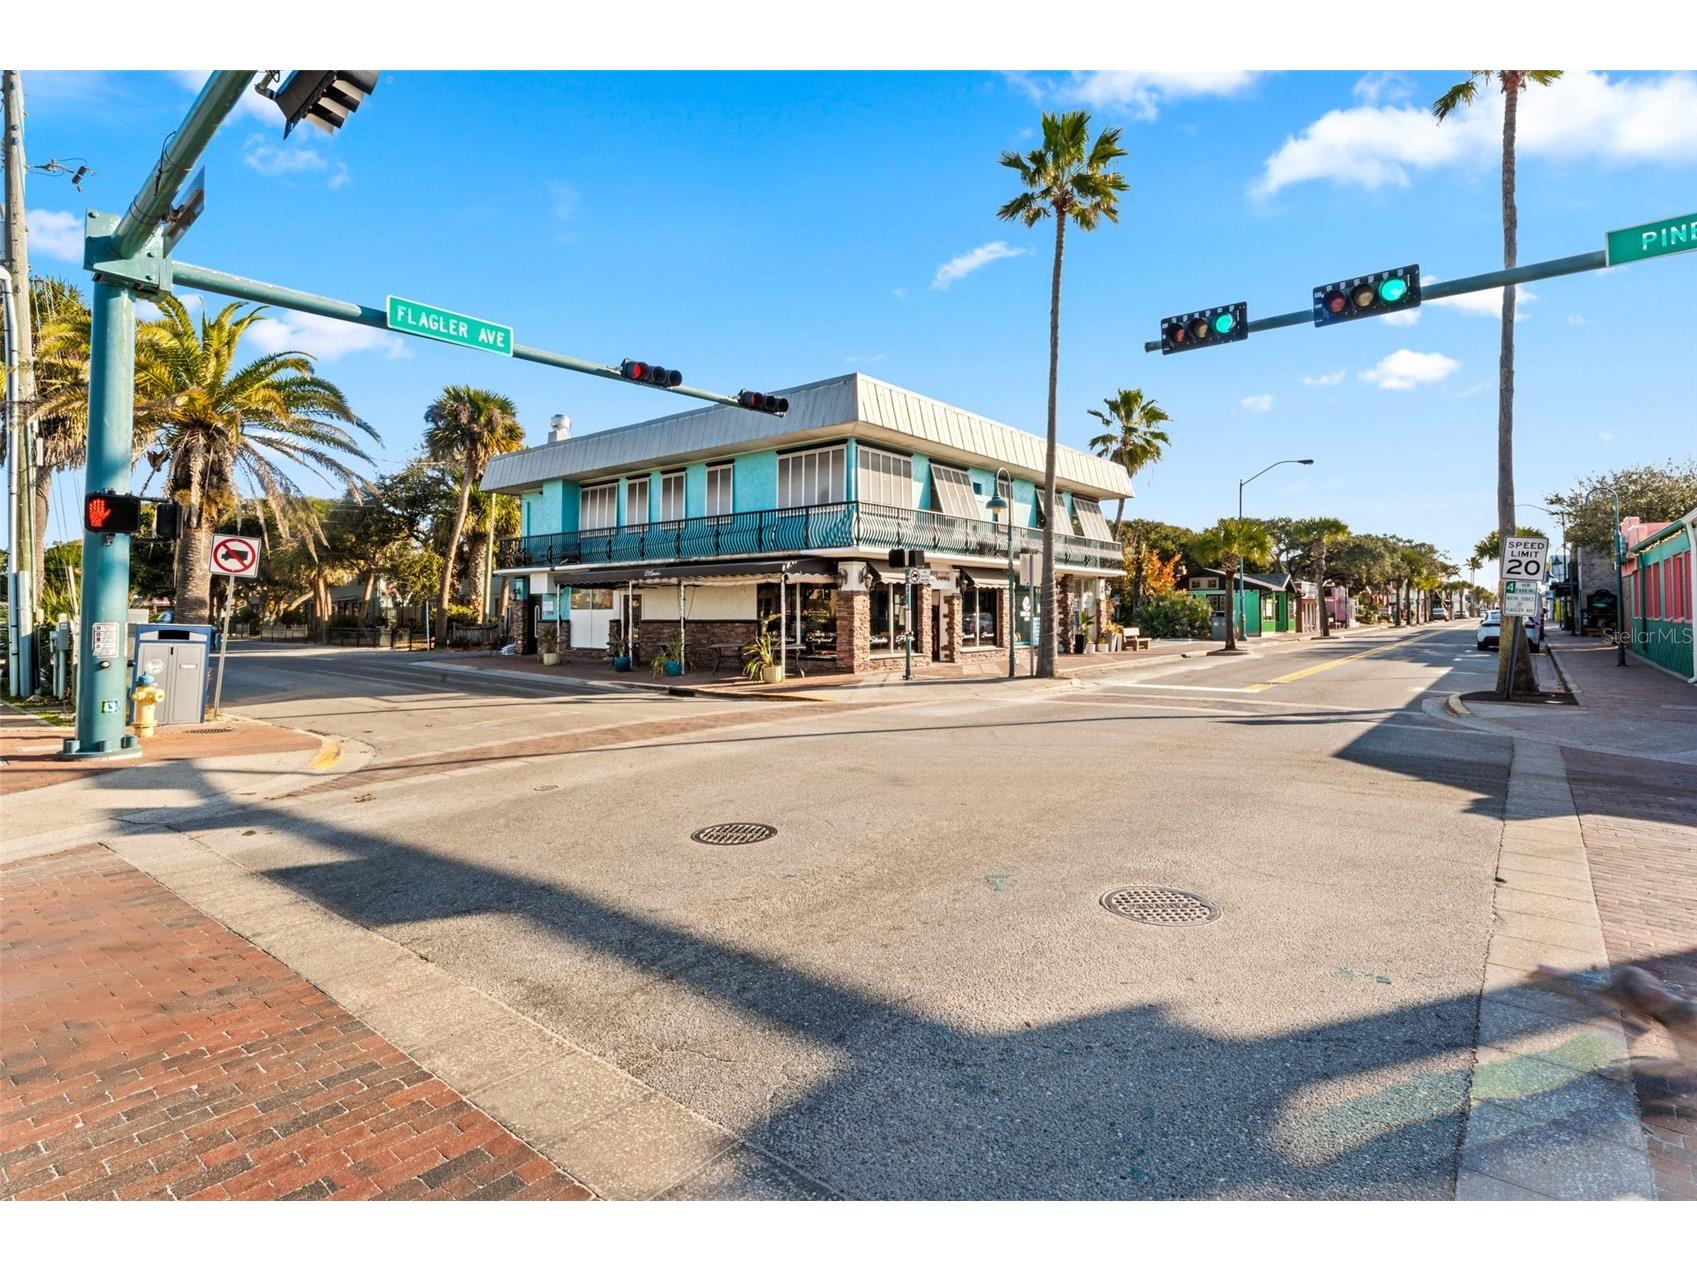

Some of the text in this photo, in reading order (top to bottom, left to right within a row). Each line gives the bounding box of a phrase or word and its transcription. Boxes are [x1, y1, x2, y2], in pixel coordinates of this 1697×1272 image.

[397, 304, 505, 347] FLAGLER AVE
[1508, 541, 1545, 549] SPEED
[1506, 559, 1540, 575] 20
[1506, 582, 1514, 592] 4
